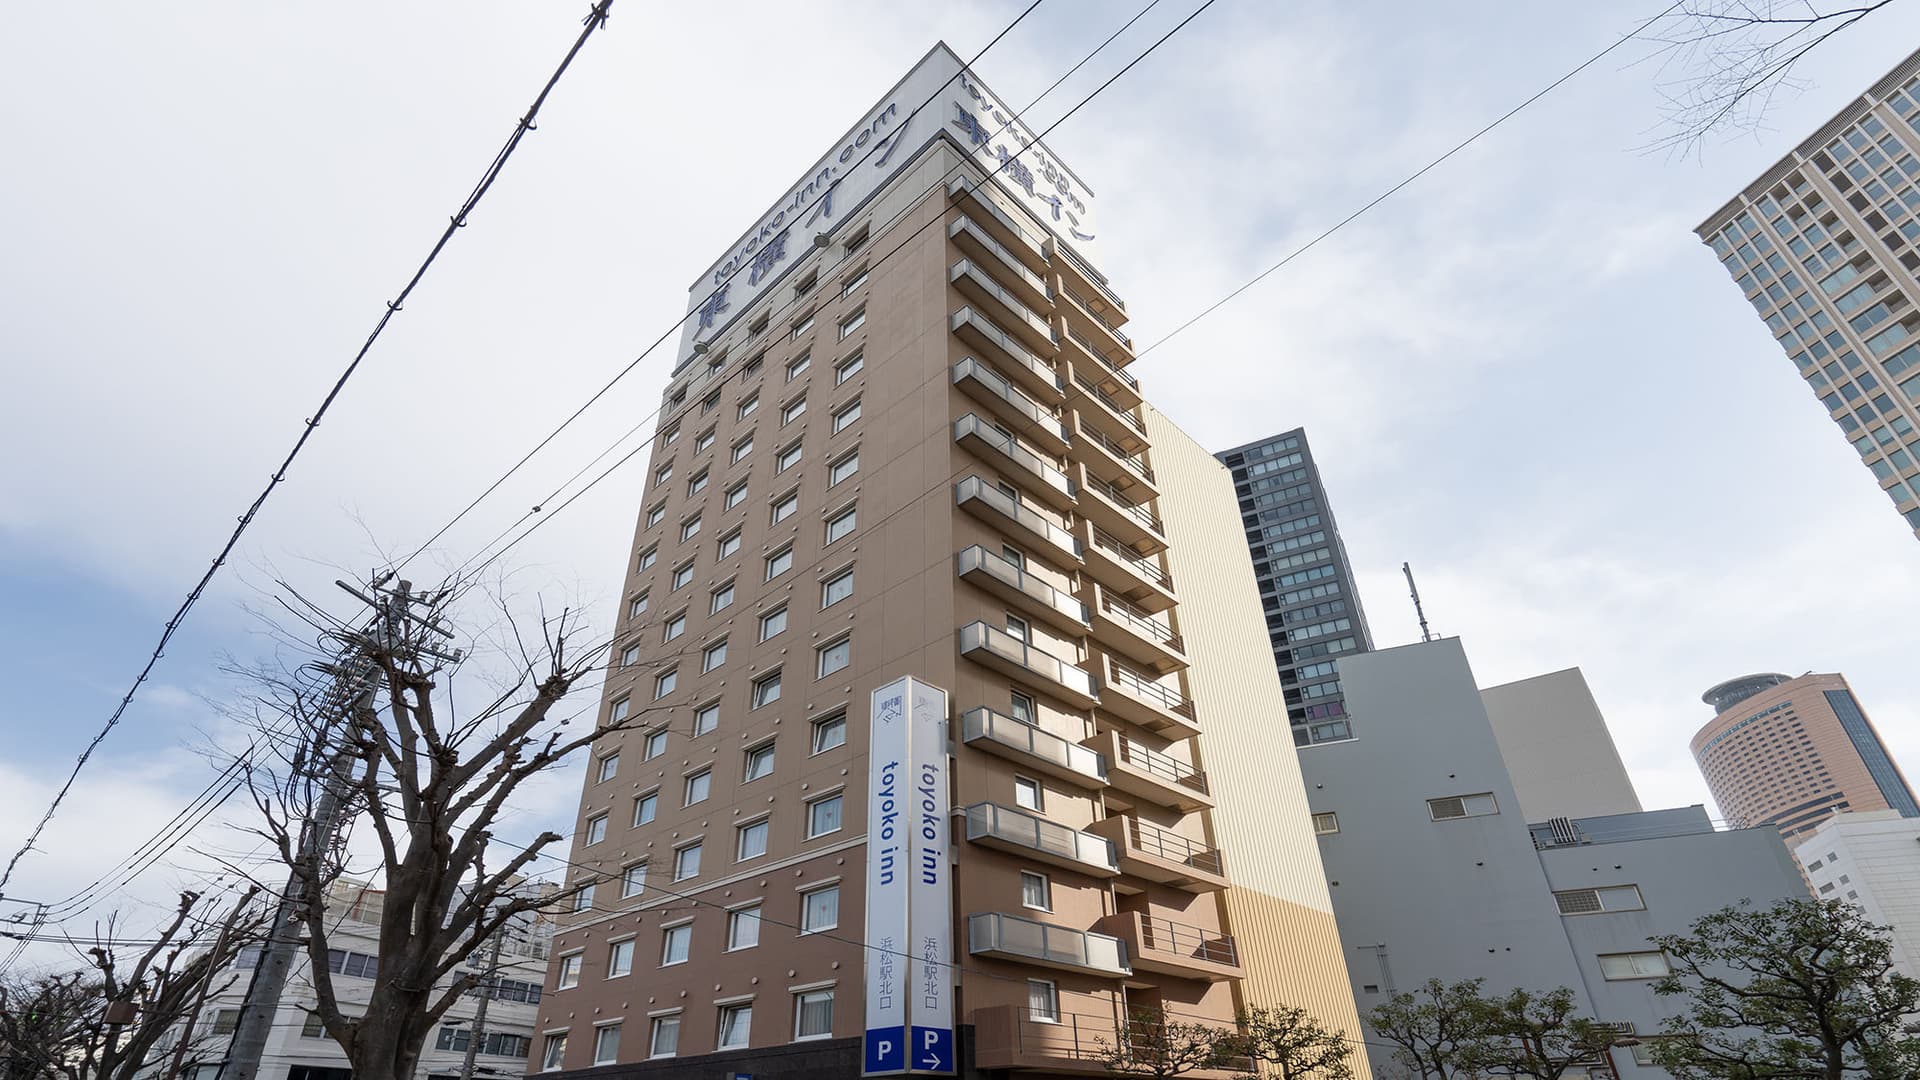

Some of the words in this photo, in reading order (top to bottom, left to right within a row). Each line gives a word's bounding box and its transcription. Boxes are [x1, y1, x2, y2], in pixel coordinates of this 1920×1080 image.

[714, 102, 897, 285] toyoko-inn.com
[878, 761, 899, 840] toyoko
[918, 763, 941, 840] toyoko
[880, 847, 898, 885] inn
[922, 848, 941, 885] inn
[879, 936, 893, 1010] 浜松駅北口
[923, 936, 938, 1010] 浜松駅北口
[878, 1040, 892, 1061] P
[925, 1031, 939, 1050] P
